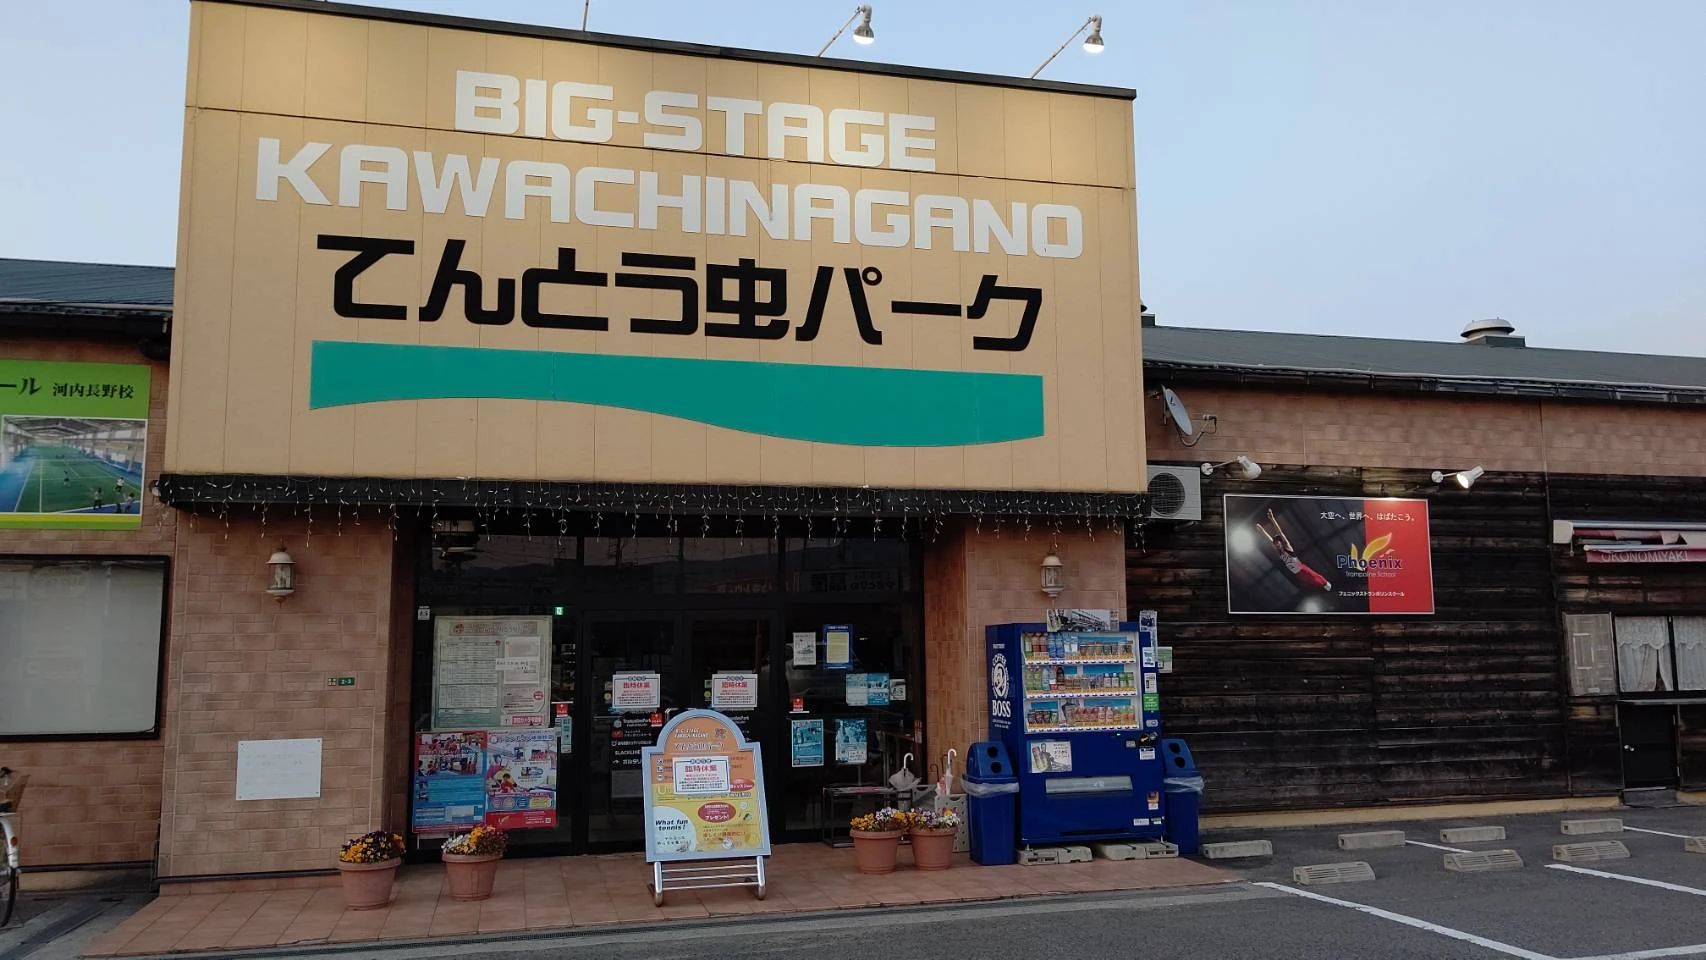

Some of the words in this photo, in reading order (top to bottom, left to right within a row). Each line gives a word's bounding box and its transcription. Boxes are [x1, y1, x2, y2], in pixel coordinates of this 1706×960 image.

[455, 69, 936, 173] BIG-STAGE
[255, 137, 1084, 259] KAWACHINAGANO
[316, 234, 1043, 351] てんとう虫パーク
[52, 383, 134, 399] 河内長野校
[1320, 511, 1415, 522] 大空へ、世界へ、はばたこう。
[1336, 554, 1402, 569] Phoenix
[1601, 550, 1688, 563] OKONOMIYAKI
[992, 700, 1011, 717] BOSS
